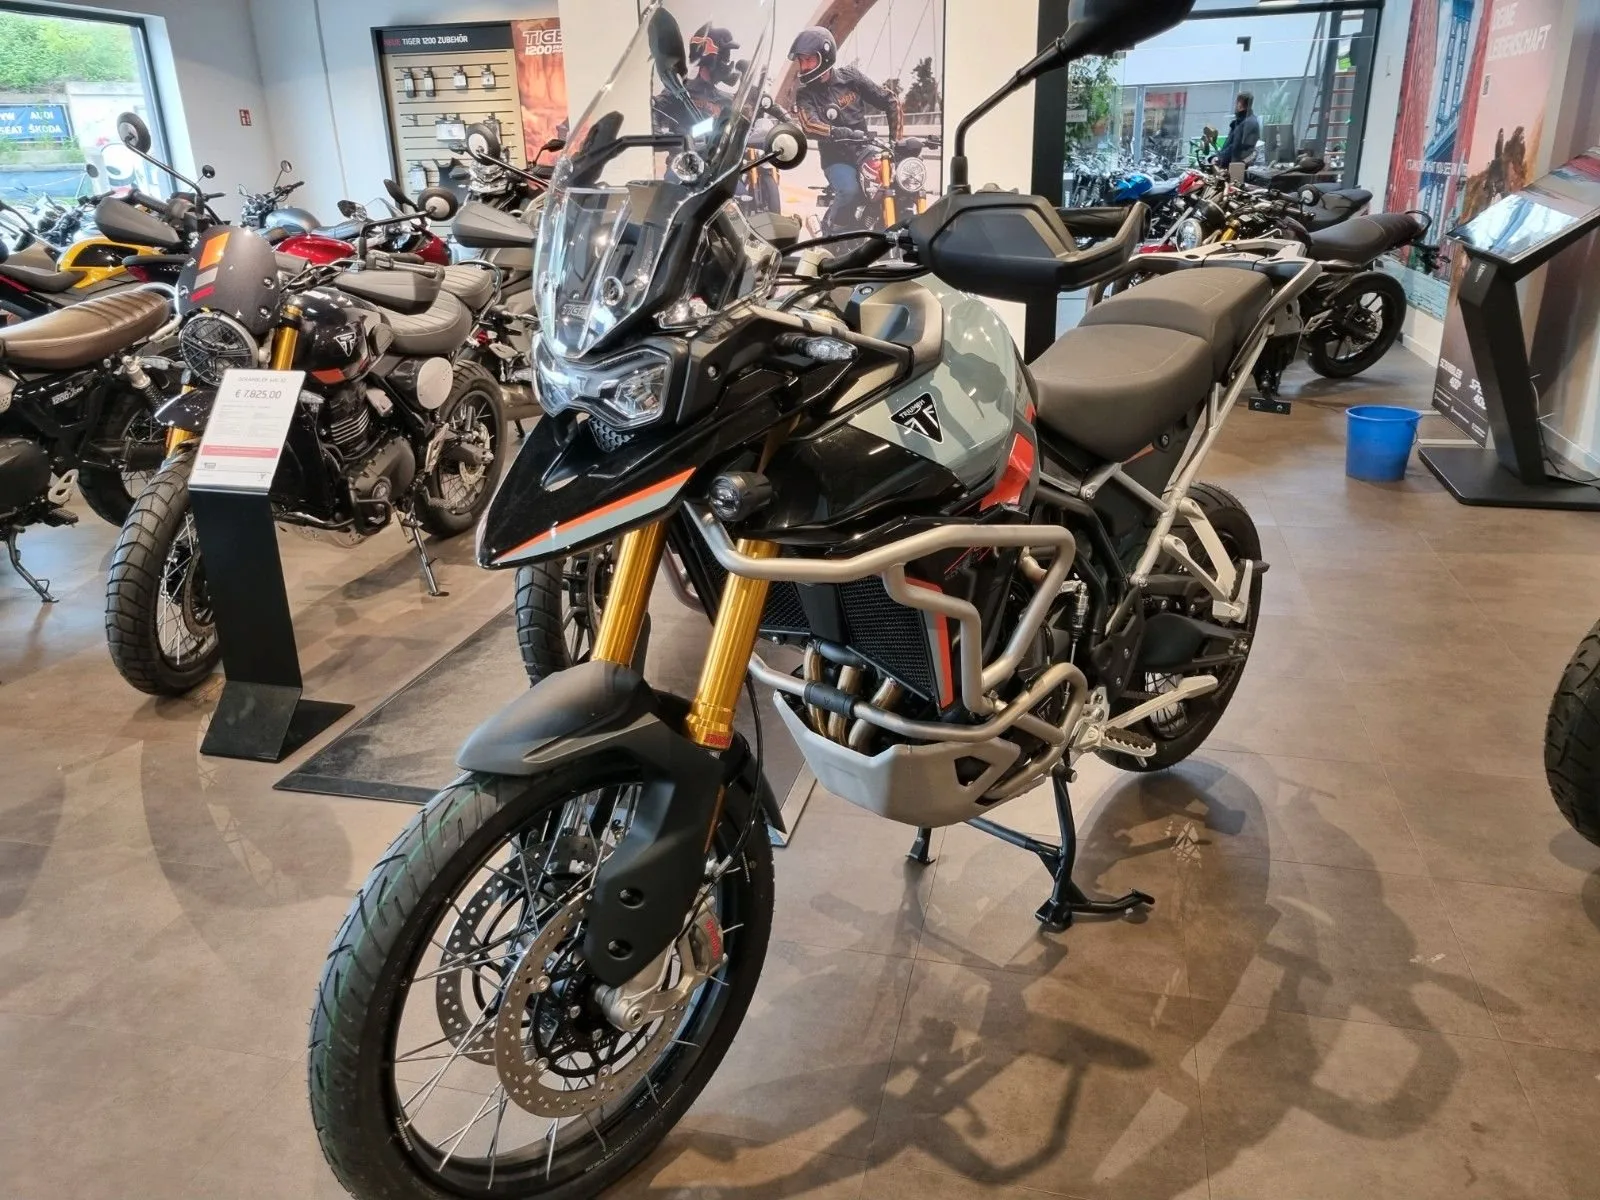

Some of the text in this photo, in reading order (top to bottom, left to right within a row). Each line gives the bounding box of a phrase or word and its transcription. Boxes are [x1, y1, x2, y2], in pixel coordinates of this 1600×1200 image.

[402, 37, 421, 46] TIGER
[421, 37, 436, 45] 1200
[437, 33, 469, 44] ZUBEHÖR
[525, 45, 552, 56] 1200
[30, 111, 54, 120] AUDI
[28, 123, 62, 134] ŠKODA
[235, 388, 242, 399] €
[898, 399, 926, 419] TRIUMPH
